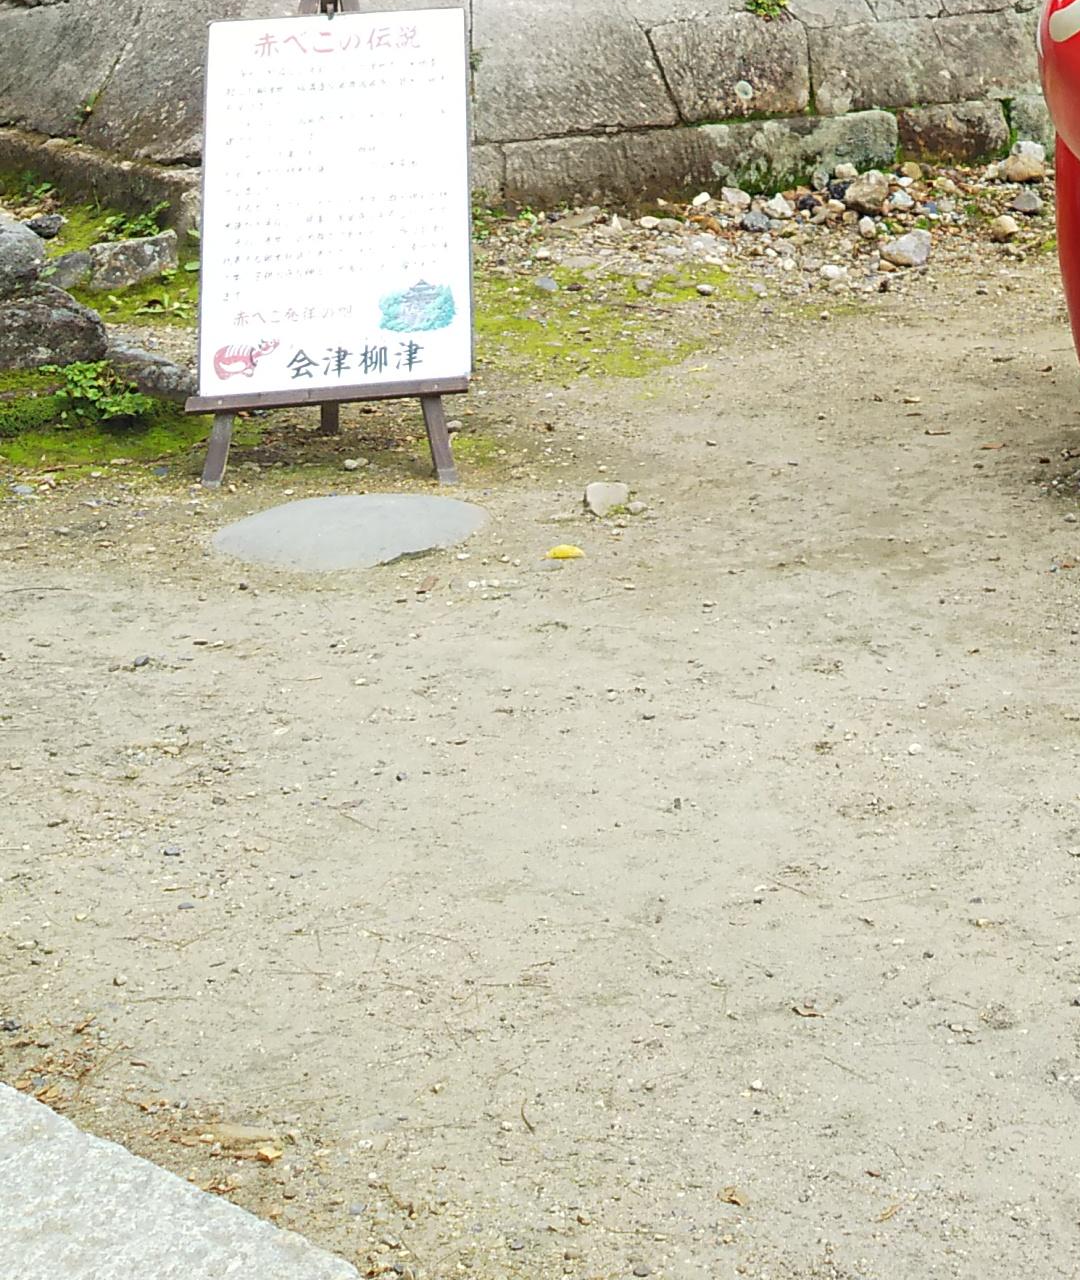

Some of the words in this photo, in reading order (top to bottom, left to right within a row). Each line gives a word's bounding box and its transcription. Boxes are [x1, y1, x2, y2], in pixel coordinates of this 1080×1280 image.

[254, 26, 420, 57] 赤べこの伝説
[286, 341, 424, 379] 会津柳津
